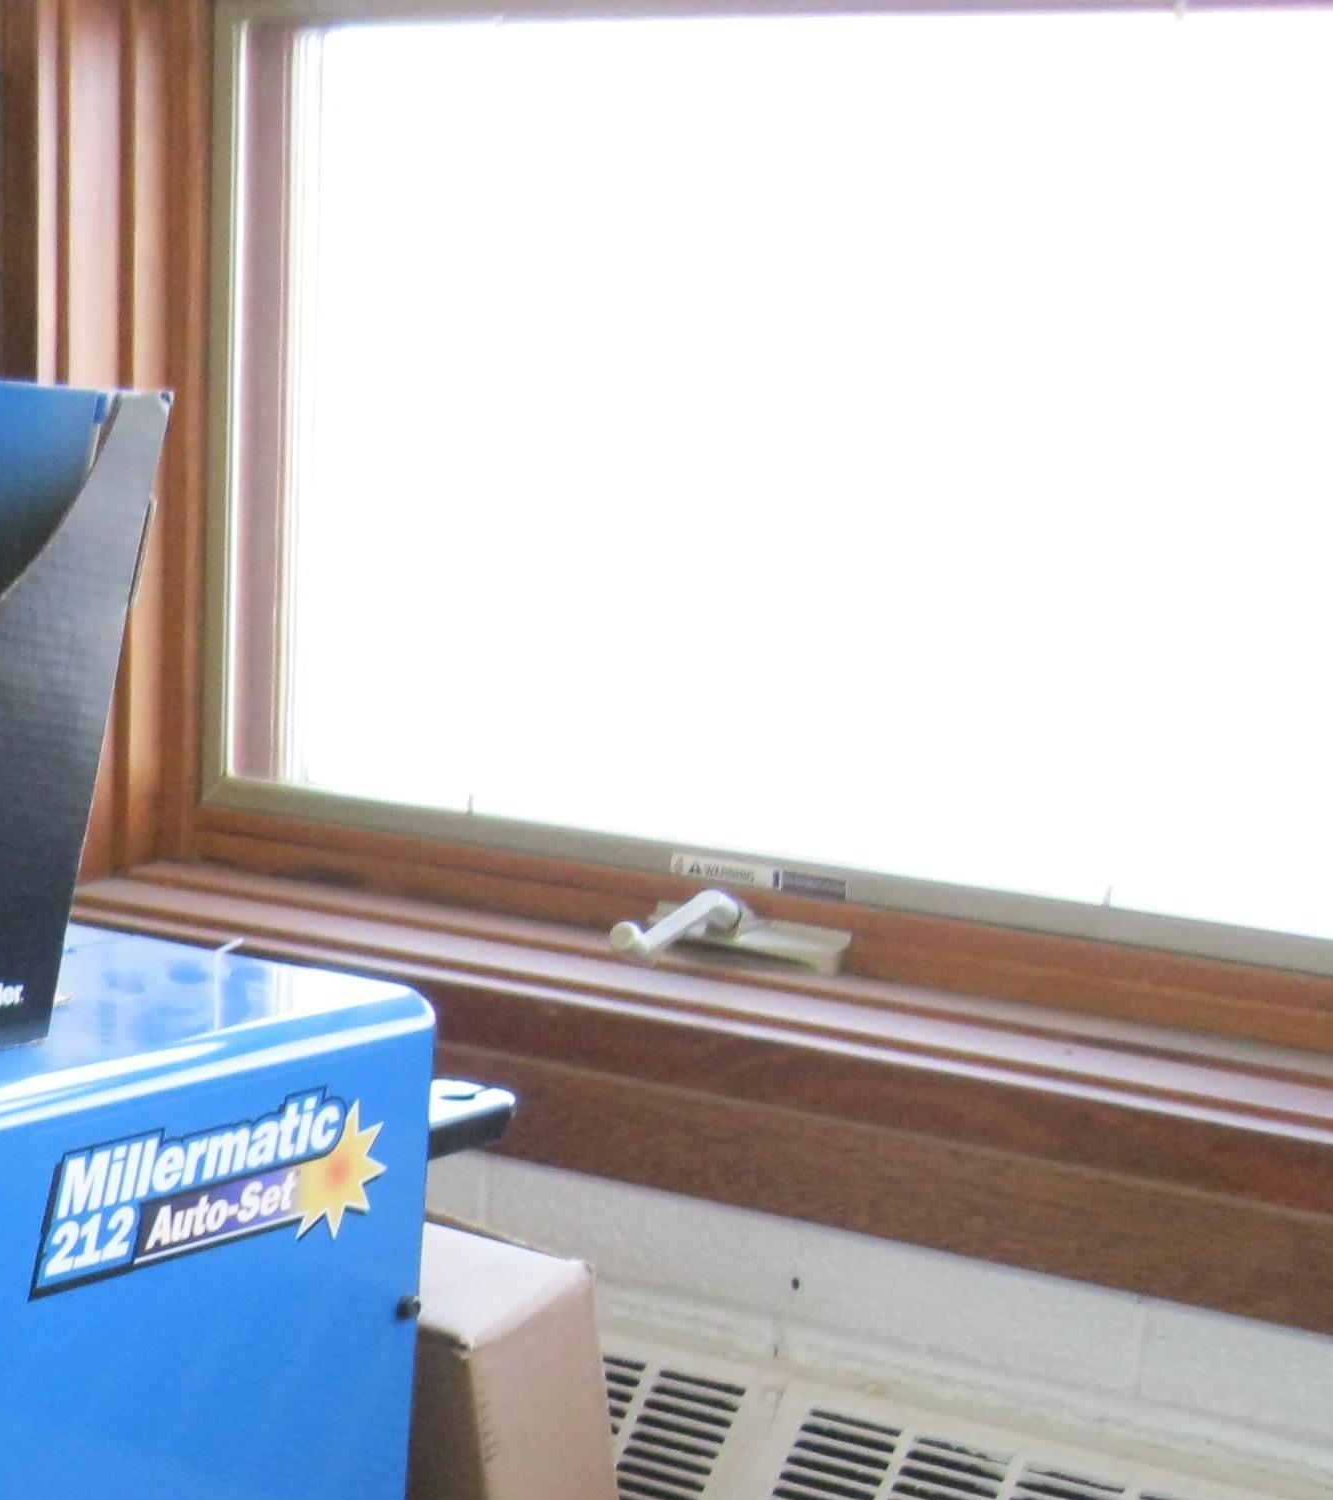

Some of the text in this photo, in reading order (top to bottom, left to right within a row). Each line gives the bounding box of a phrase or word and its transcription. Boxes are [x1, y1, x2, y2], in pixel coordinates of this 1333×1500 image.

[704, 863, 756, 884] WARNING
[56, 1094, 341, 1220] Millermatic
[43, 1171, 300, 1280] 212 Auto-Set
